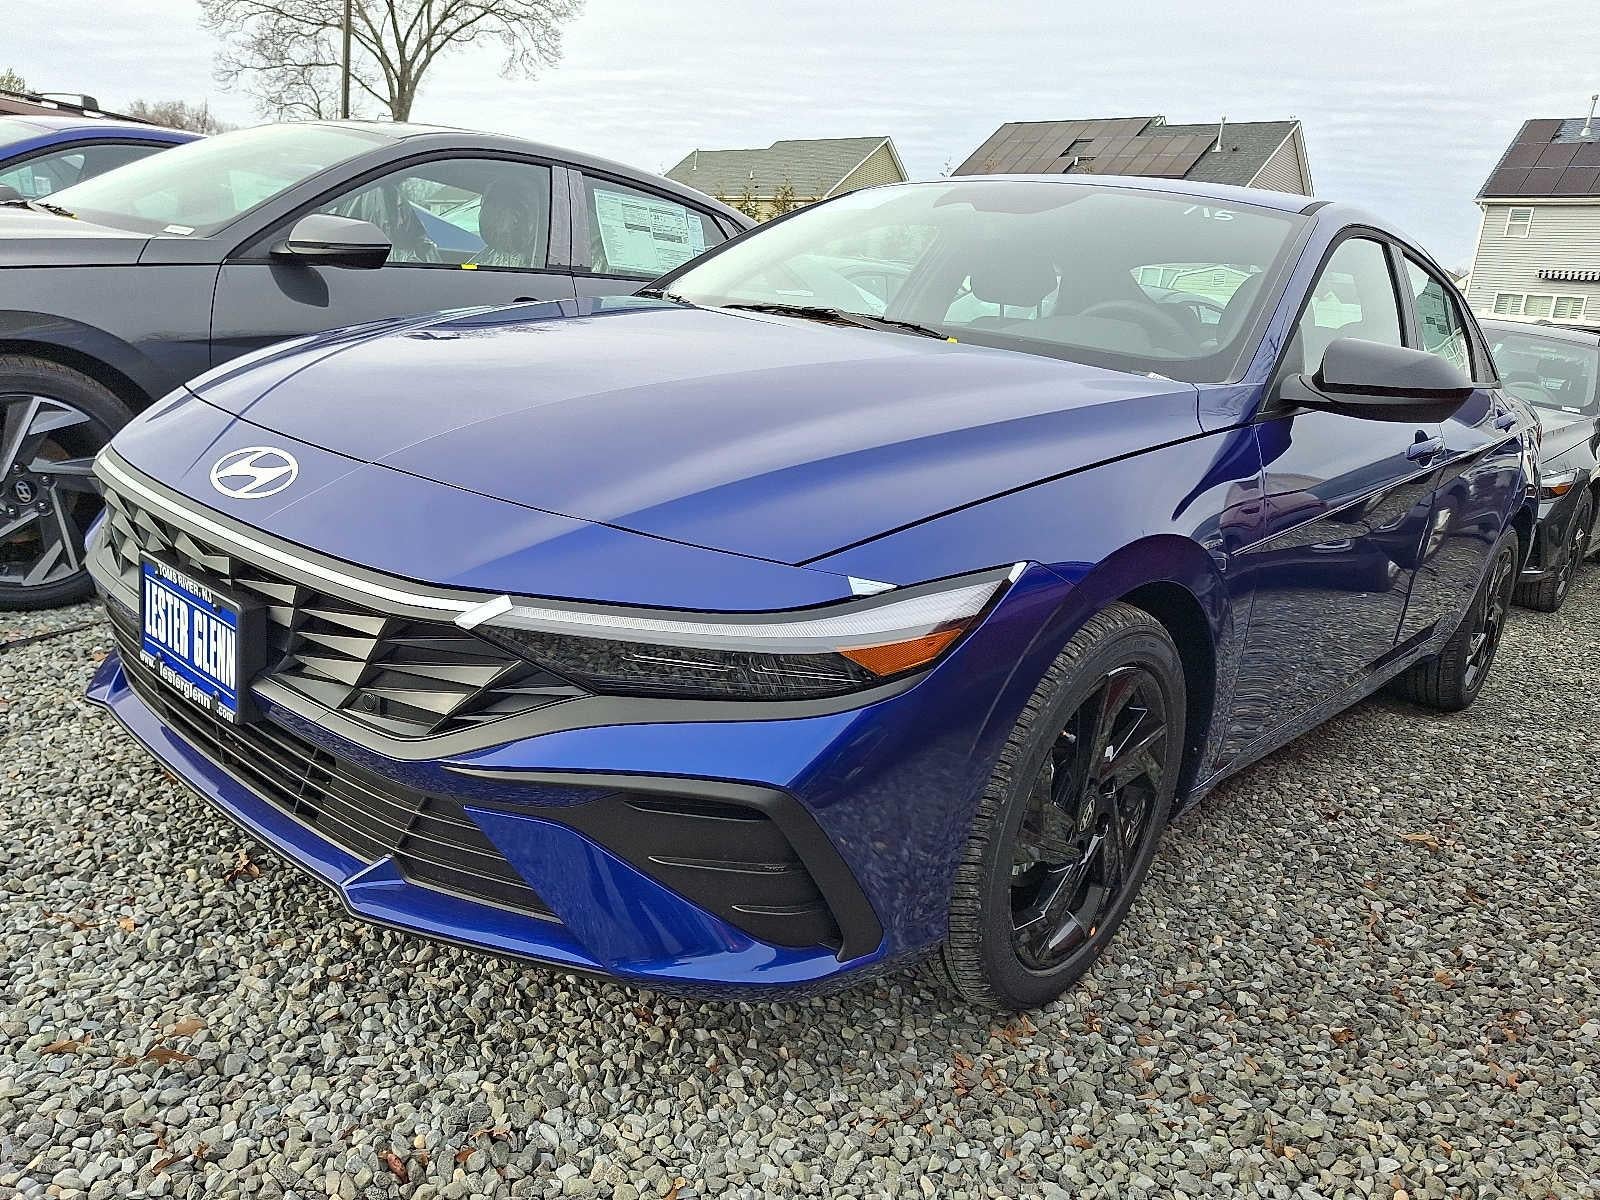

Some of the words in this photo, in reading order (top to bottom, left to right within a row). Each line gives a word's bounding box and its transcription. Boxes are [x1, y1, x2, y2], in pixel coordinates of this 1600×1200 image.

[158, 563, 178, 584] TOMS
[201, 588, 213, 604] NJ
[145, 579, 189, 660] LESTER
[193, 609, 236, 691] GLENN
